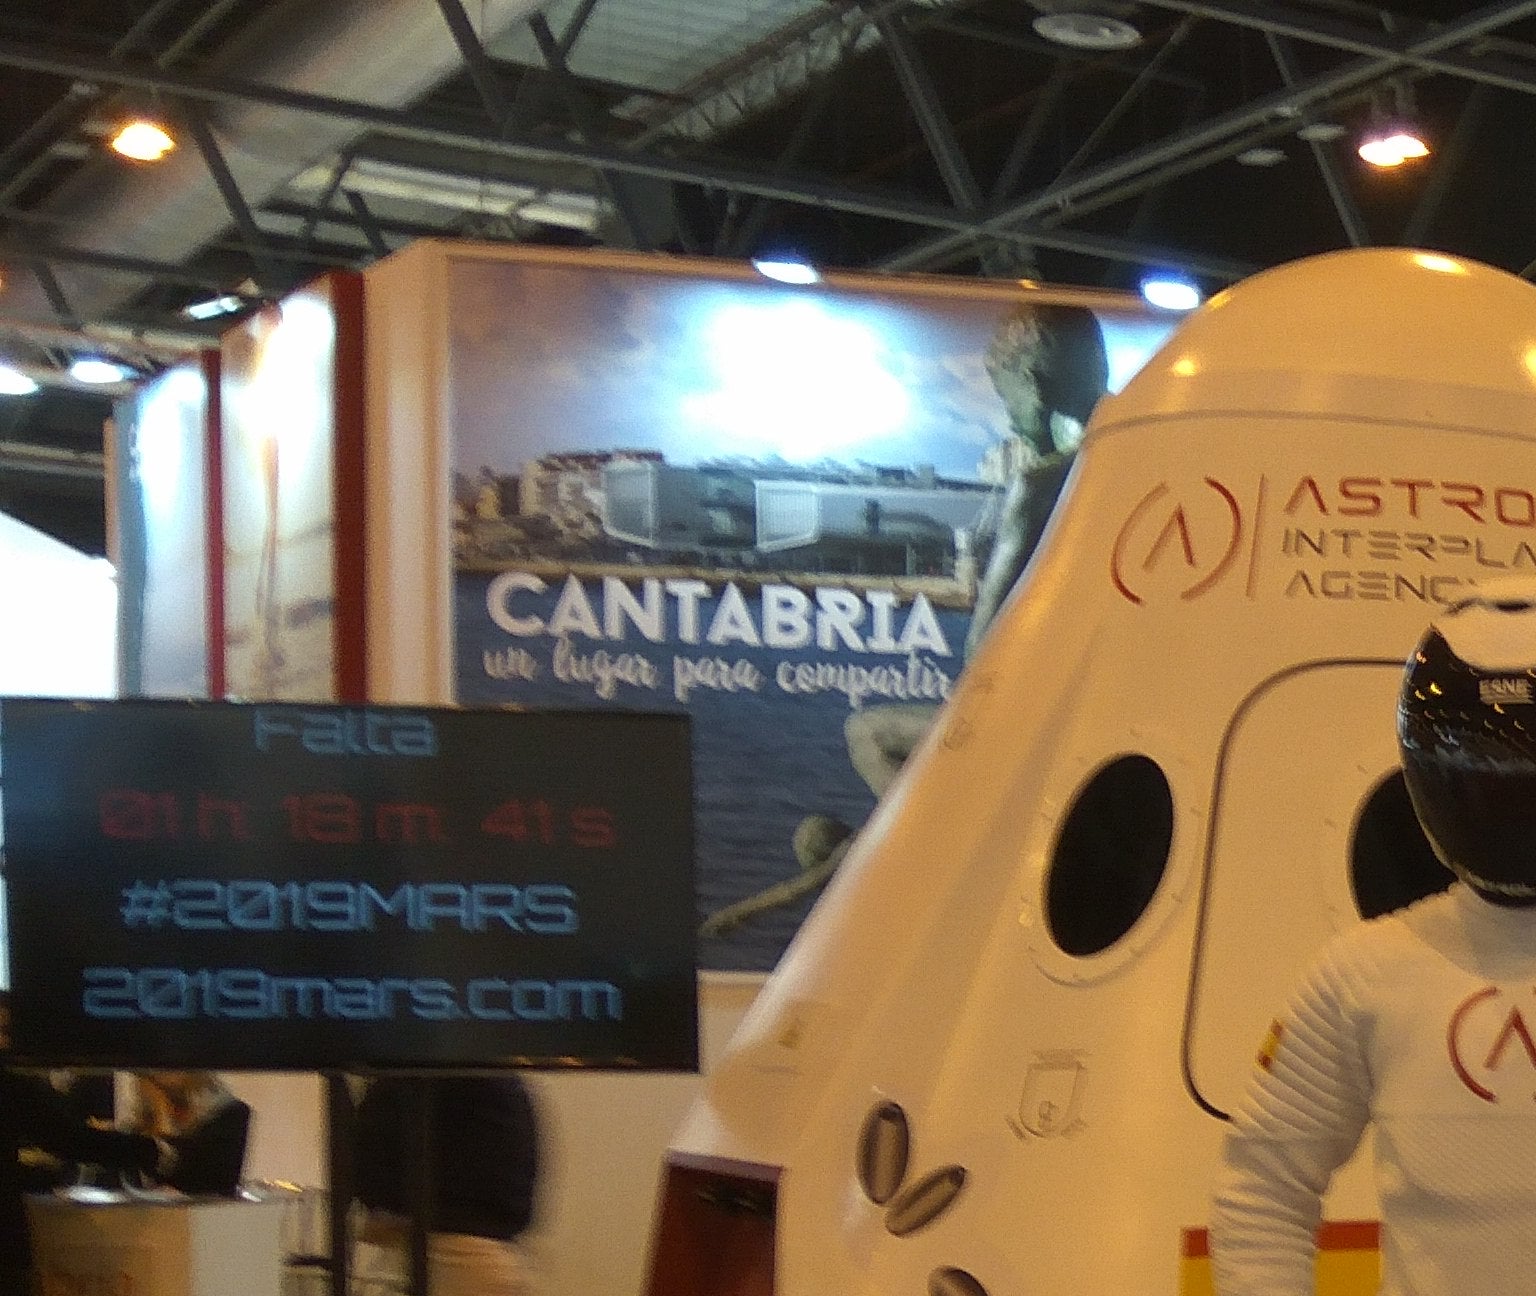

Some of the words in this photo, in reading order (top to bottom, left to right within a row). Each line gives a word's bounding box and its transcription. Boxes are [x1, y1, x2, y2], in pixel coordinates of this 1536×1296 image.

[485, 570, 952, 658] CANTABRIA
[1283, 570, 1478, 604] AGENC
[482, 646, 538, 682] un
[552, 636, 661, 700] lugar
[672, 653, 762, 701] para
[253, 706, 438, 757] Falta
[119, 878, 580, 934] #2019MARS
[82, 966, 624, 1022] 2019mars.com
